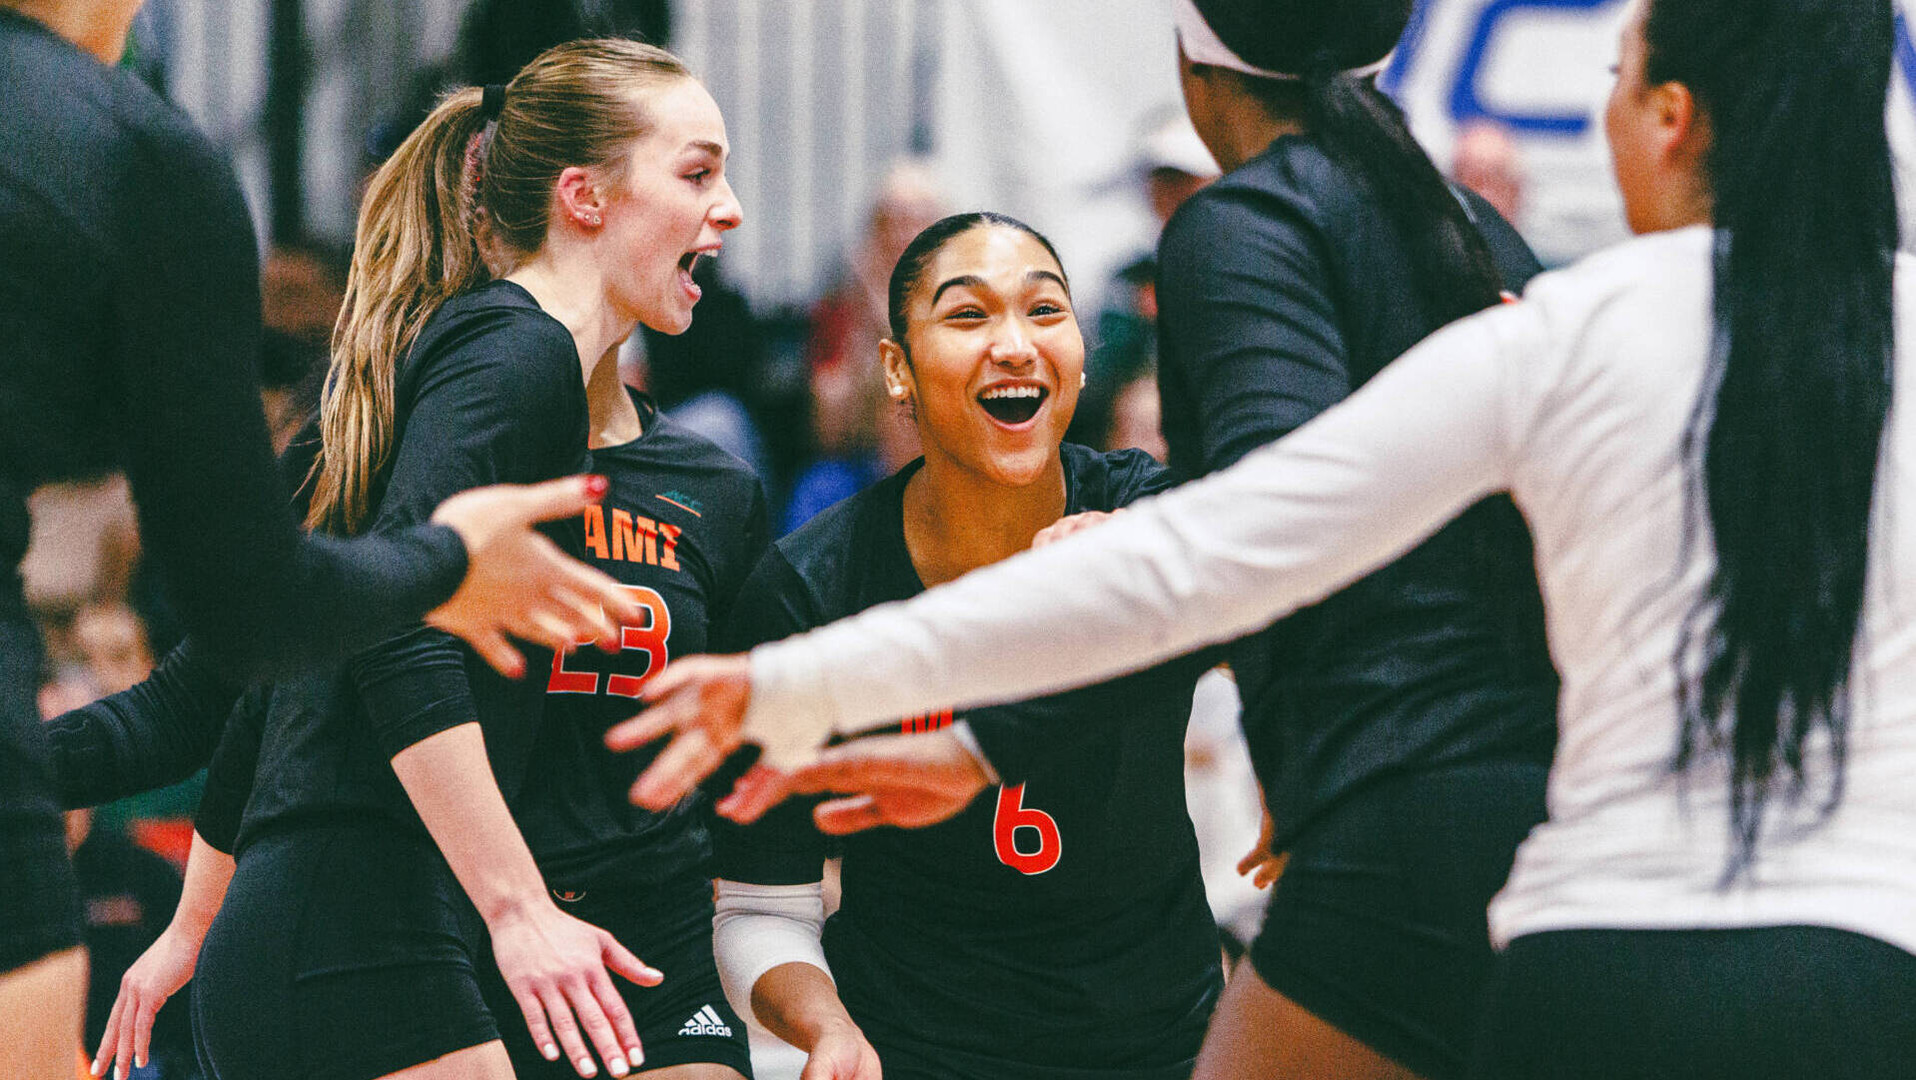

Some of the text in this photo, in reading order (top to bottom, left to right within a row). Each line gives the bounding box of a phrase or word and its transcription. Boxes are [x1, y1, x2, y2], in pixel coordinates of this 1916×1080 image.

[584, 503, 682, 572] AMI
[993, 780, 1062, 875] 6
[678, 1022, 732, 1037] adidas
